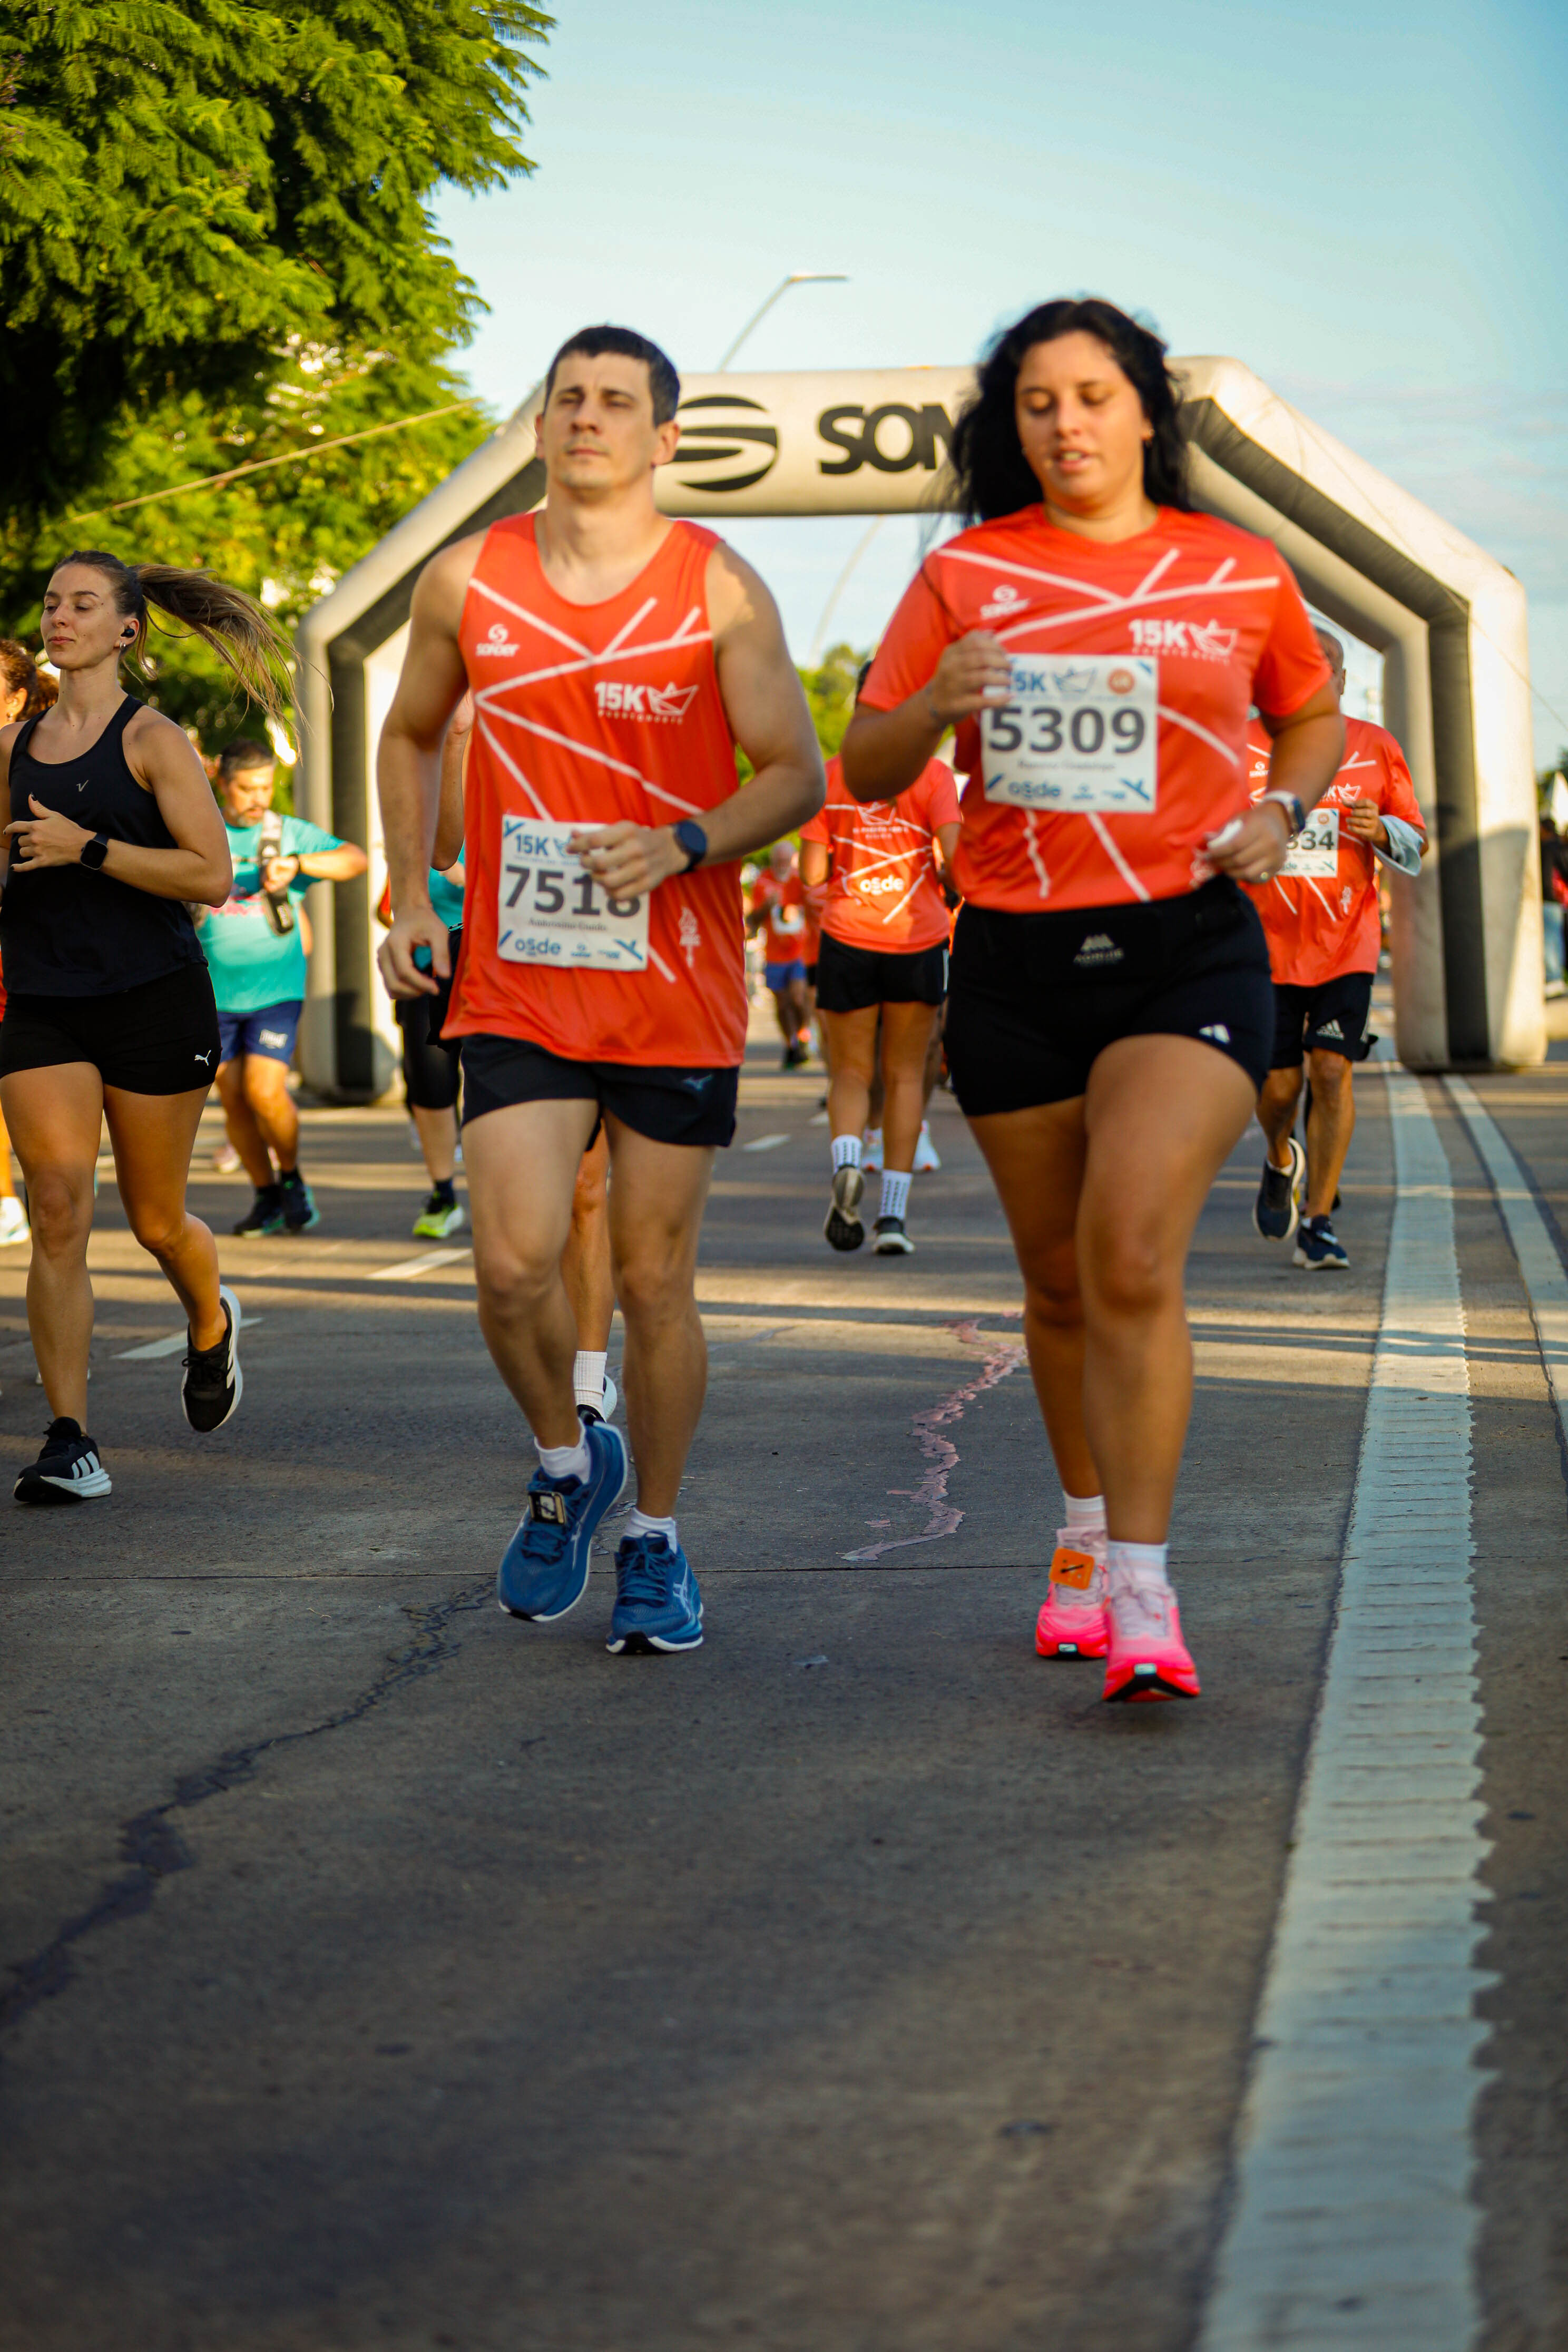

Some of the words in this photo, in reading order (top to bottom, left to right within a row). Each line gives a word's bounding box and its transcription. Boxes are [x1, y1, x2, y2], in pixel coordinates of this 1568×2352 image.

[1128, 619, 1189, 648] 15K
[1005, 669, 1046, 692] 5K
[594, 681, 646, 712] 15K
[988, 707, 1145, 753] 5309
[515, 834, 548, 856] 15K
[860, 875, 904, 893] osde
[515, 937, 561, 955] osde
